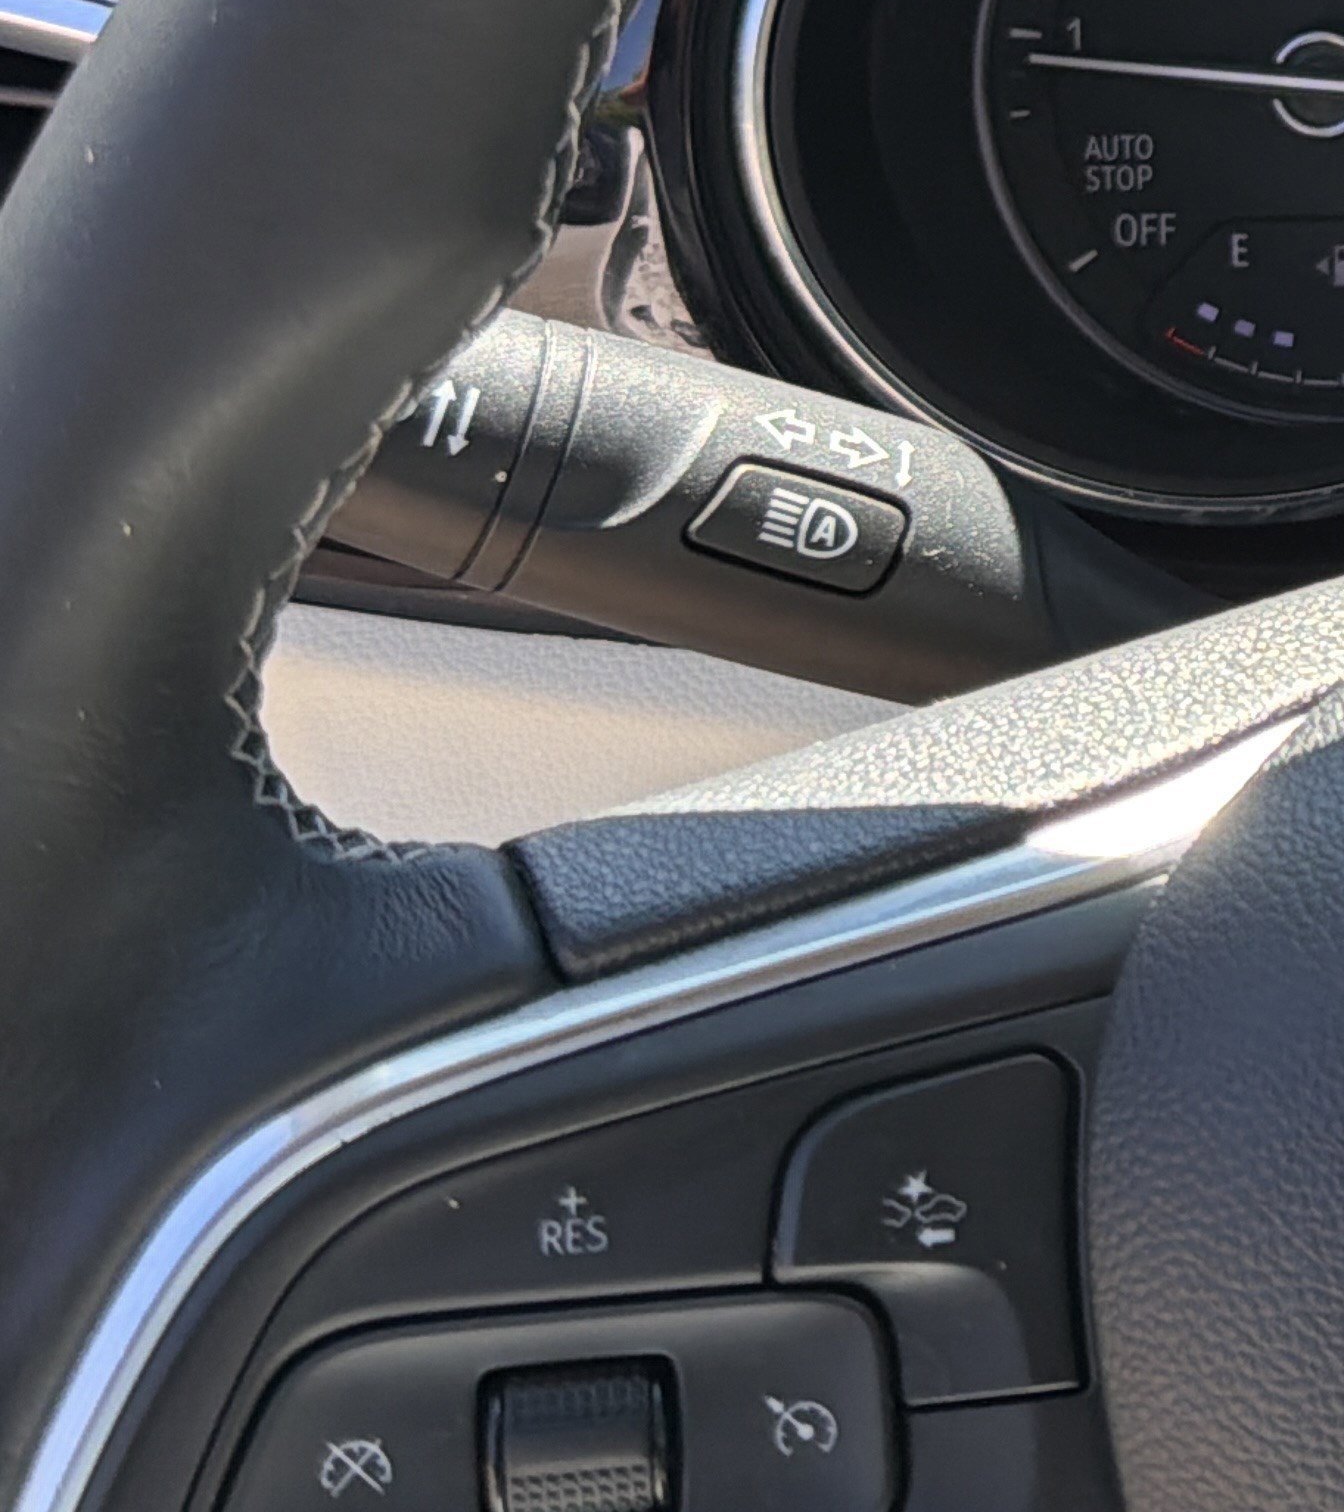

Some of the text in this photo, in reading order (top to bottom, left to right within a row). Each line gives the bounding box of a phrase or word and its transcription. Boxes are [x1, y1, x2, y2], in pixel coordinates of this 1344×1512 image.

[1066, 19, 1082, 50] 1
[1084, 134, 1154, 161] AUTO
[1085, 164, 1154, 192] STOP
[1114, 213, 1176, 246] OFF
[1231, 235, 1249, 268] E
[540, 1217, 609, 1257] RES
